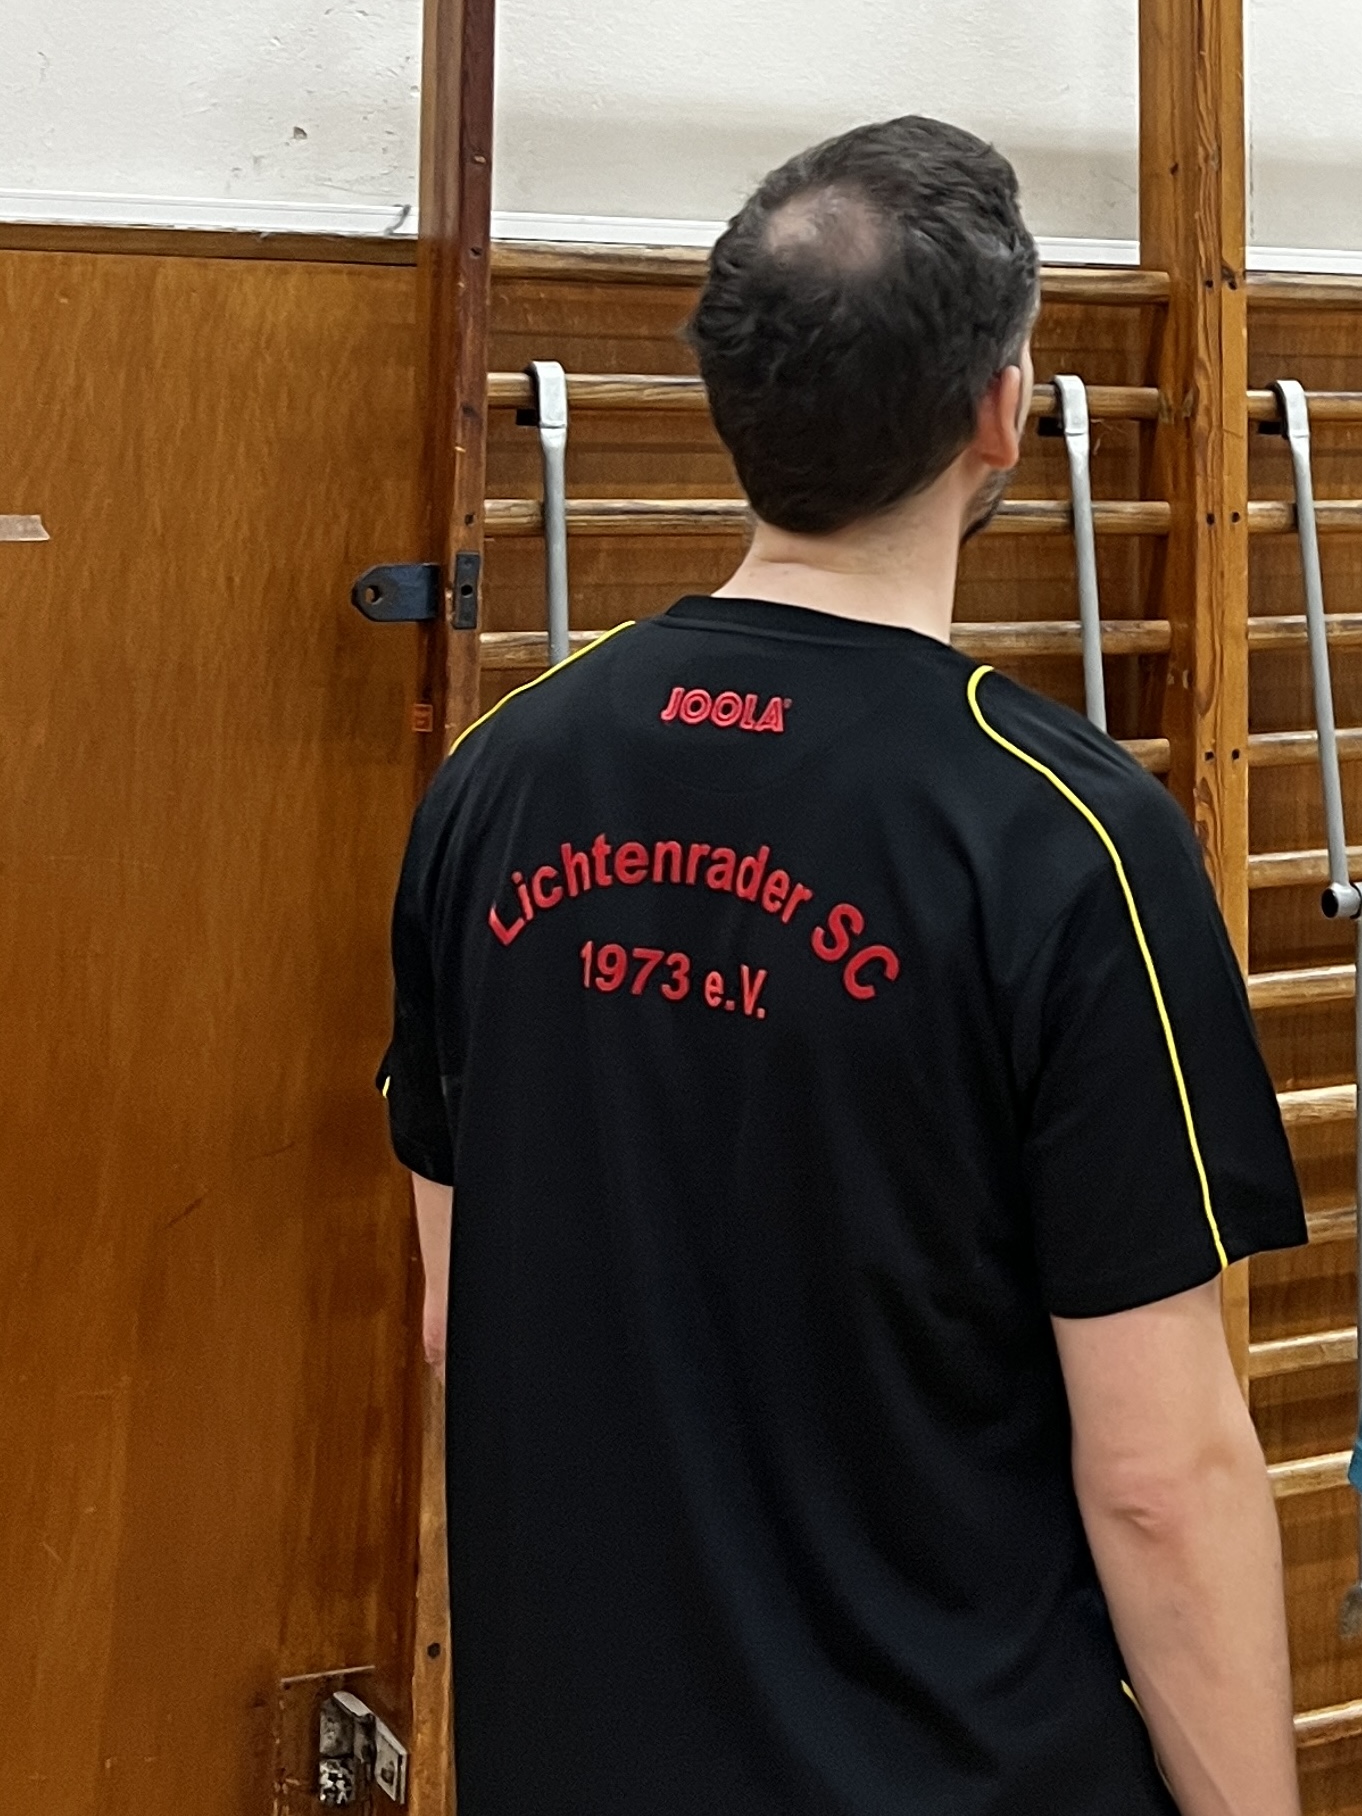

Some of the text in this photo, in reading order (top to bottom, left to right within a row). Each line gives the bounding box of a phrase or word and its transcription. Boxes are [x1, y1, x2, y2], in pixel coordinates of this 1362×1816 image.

[660, 686, 784, 732] JOOLA
[488, 833, 900, 1000] Lichtenrader SC
[580, 941, 767, 1019] 1973 e.V.
